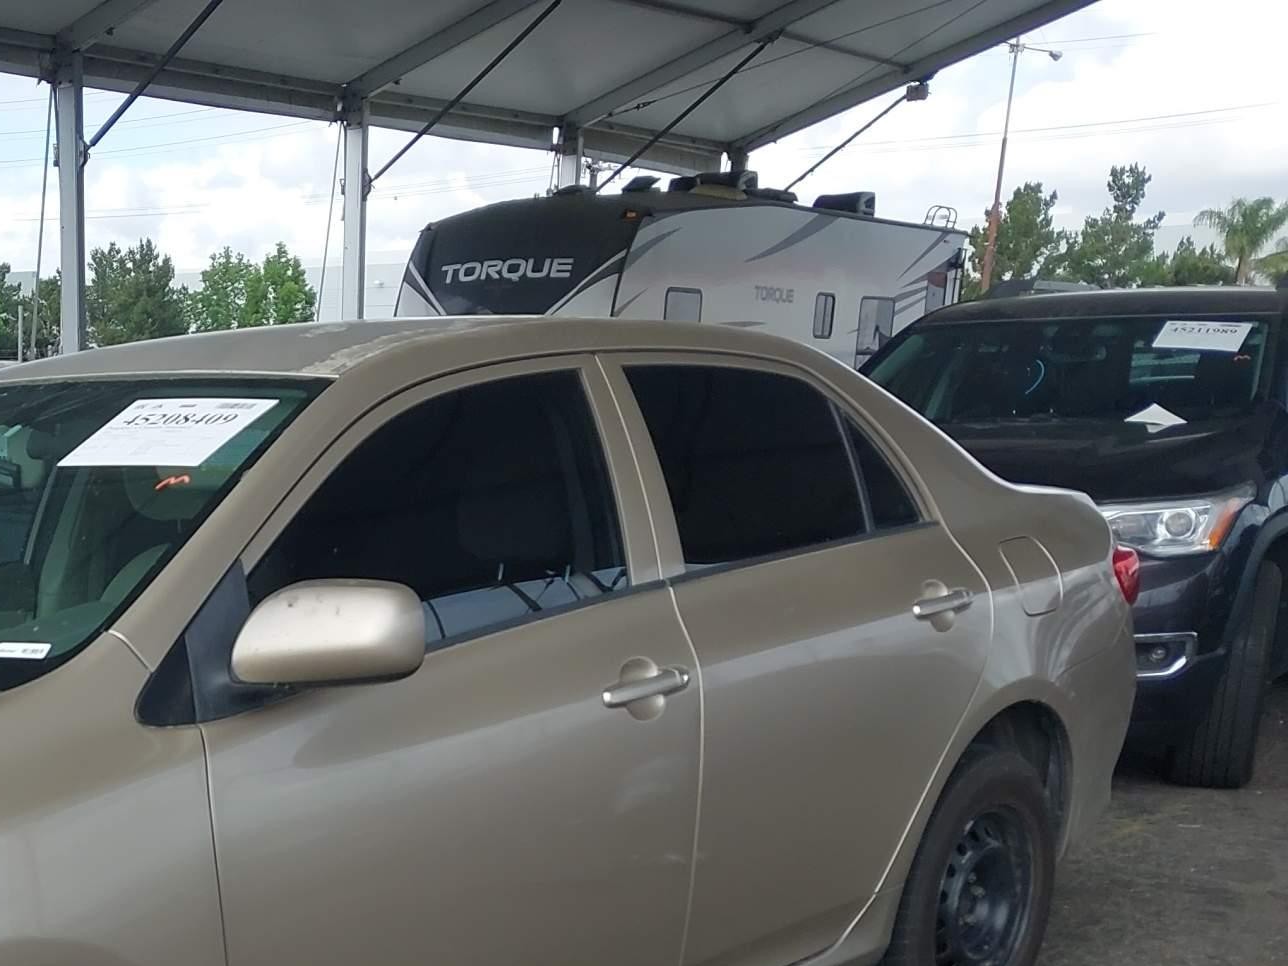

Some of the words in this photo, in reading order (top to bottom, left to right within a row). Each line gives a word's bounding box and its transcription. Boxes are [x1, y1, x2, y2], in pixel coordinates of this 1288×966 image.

[441, 258, 574, 284] TORQUE
[754, 285, 794, 304] TORQUE
[123, 413, 239, 426] 45208409
